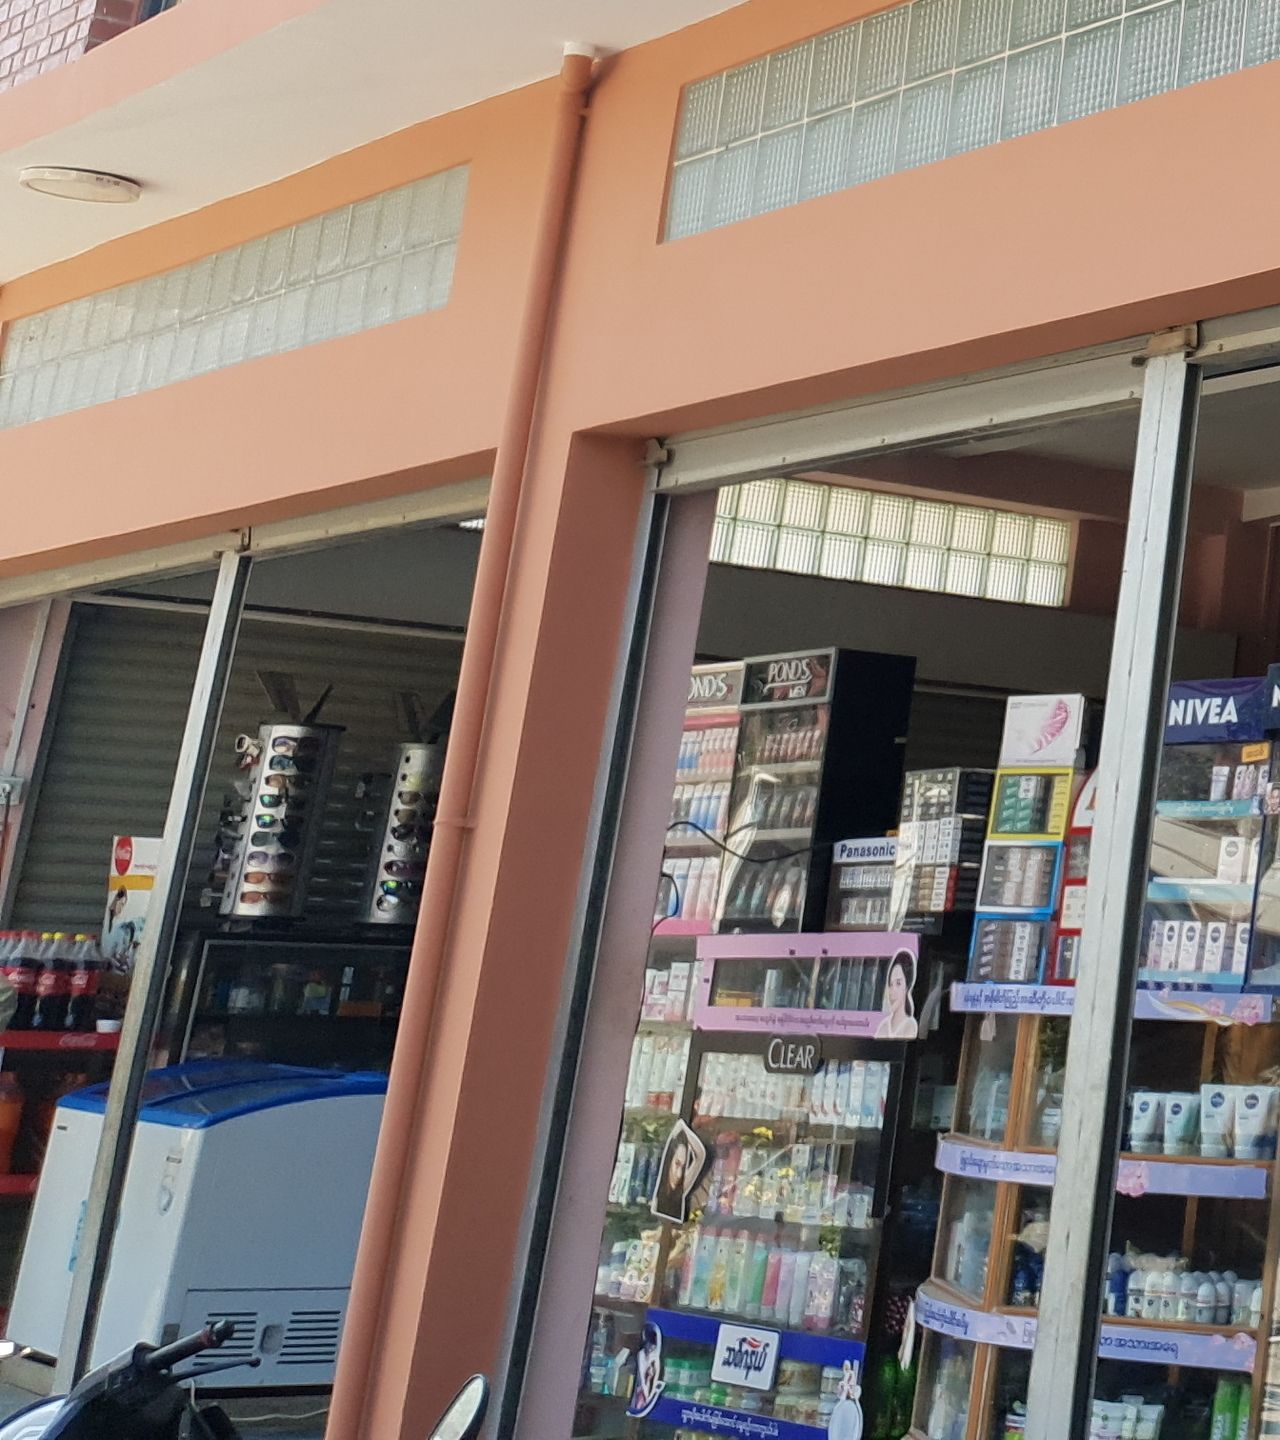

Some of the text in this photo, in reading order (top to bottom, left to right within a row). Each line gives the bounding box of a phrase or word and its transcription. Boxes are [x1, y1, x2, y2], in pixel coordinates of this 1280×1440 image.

[1168, 696, 1239, 727] NIVEA
[840, 842, 896, 859] Panasonic
[768, 1038, 815, 1071] CLEAR
